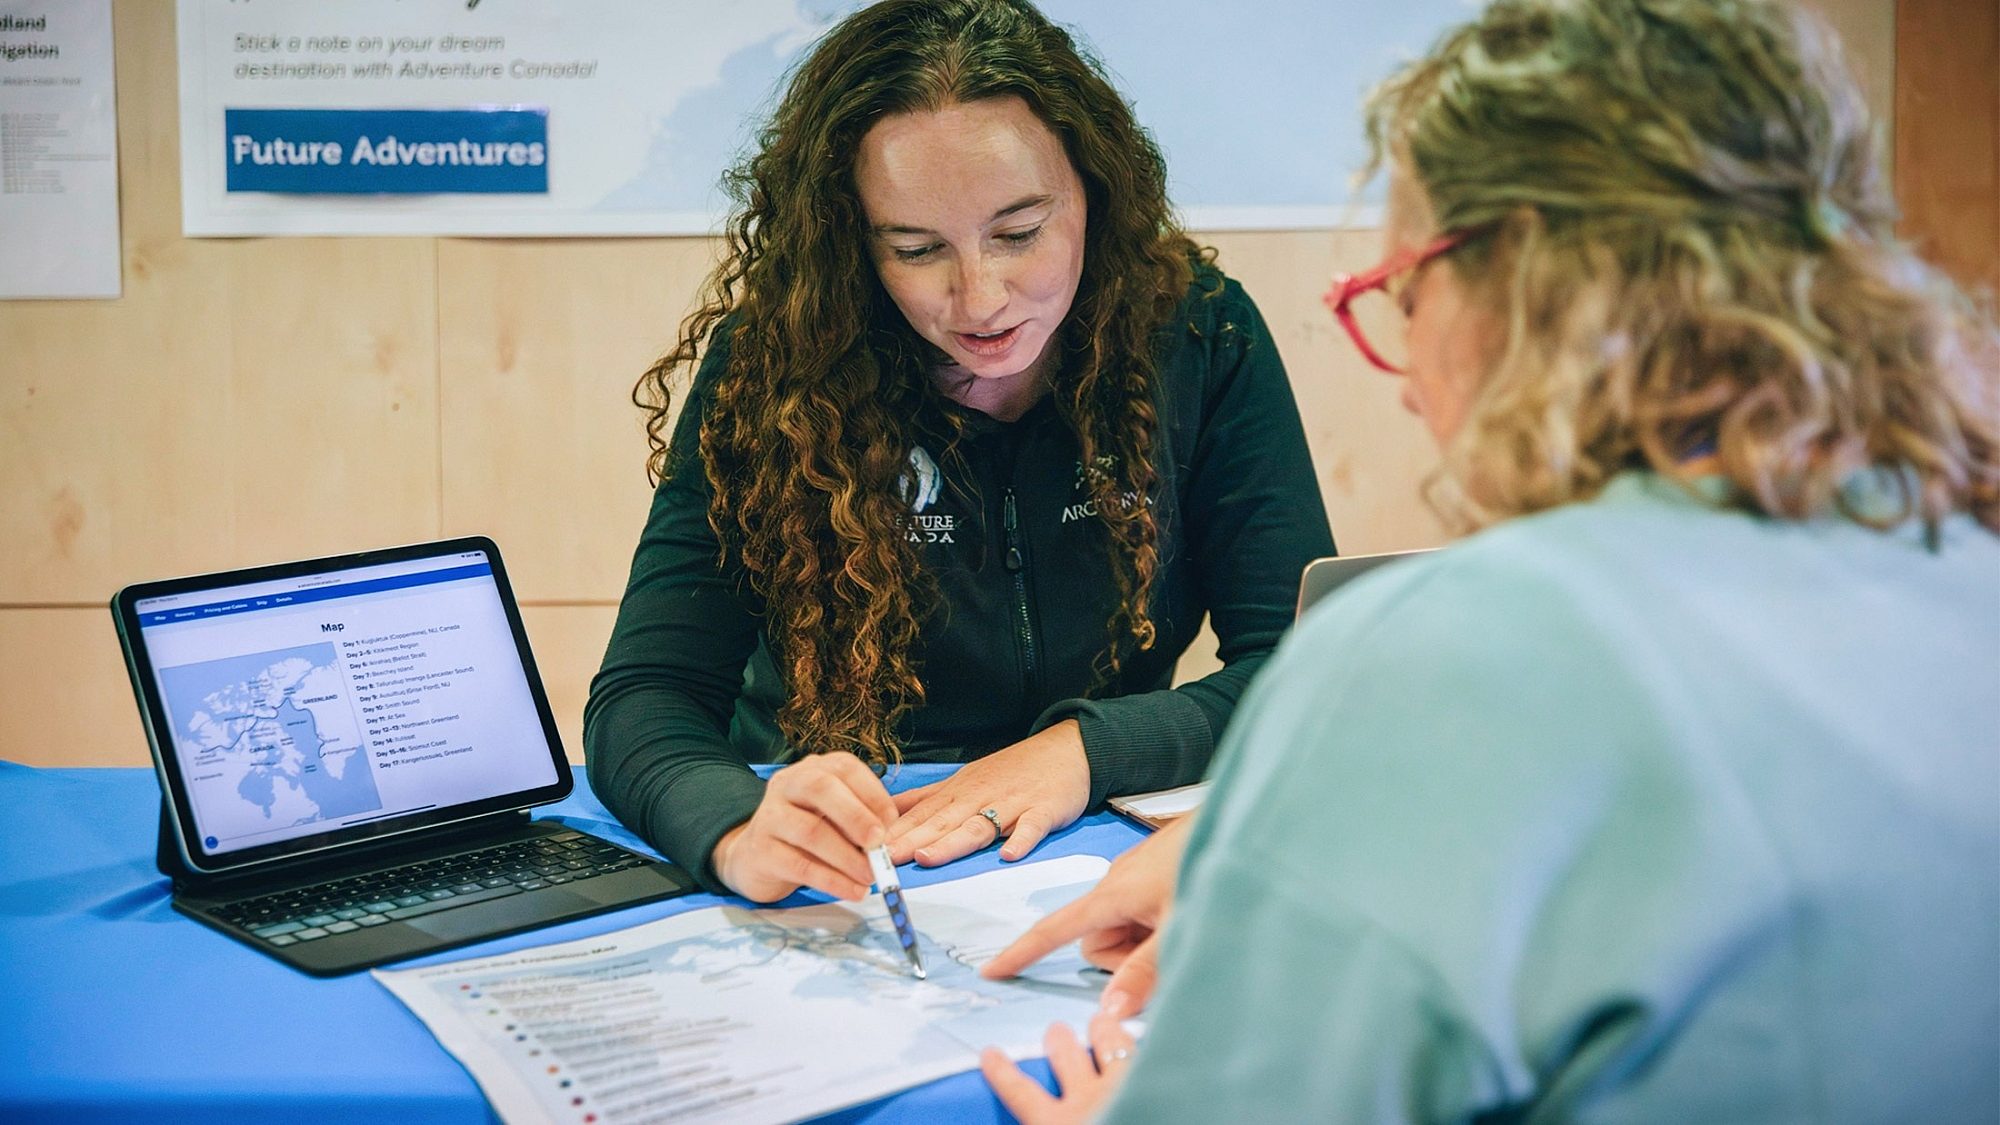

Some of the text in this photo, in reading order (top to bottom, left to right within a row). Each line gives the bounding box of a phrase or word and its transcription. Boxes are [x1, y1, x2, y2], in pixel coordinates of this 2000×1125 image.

[0, 42, 59, 62] igation
[234, 32, 505, 56] Stick a note on your dream
[234, 59, 598, 79] destination with Adventure Canada!
[232, 135, 545, 166] Future Adventures
[321, 622, 345, 633] Map
[303, 694, 338, 704] GREENLAND
[444, 746, 474, 756] Greenland
